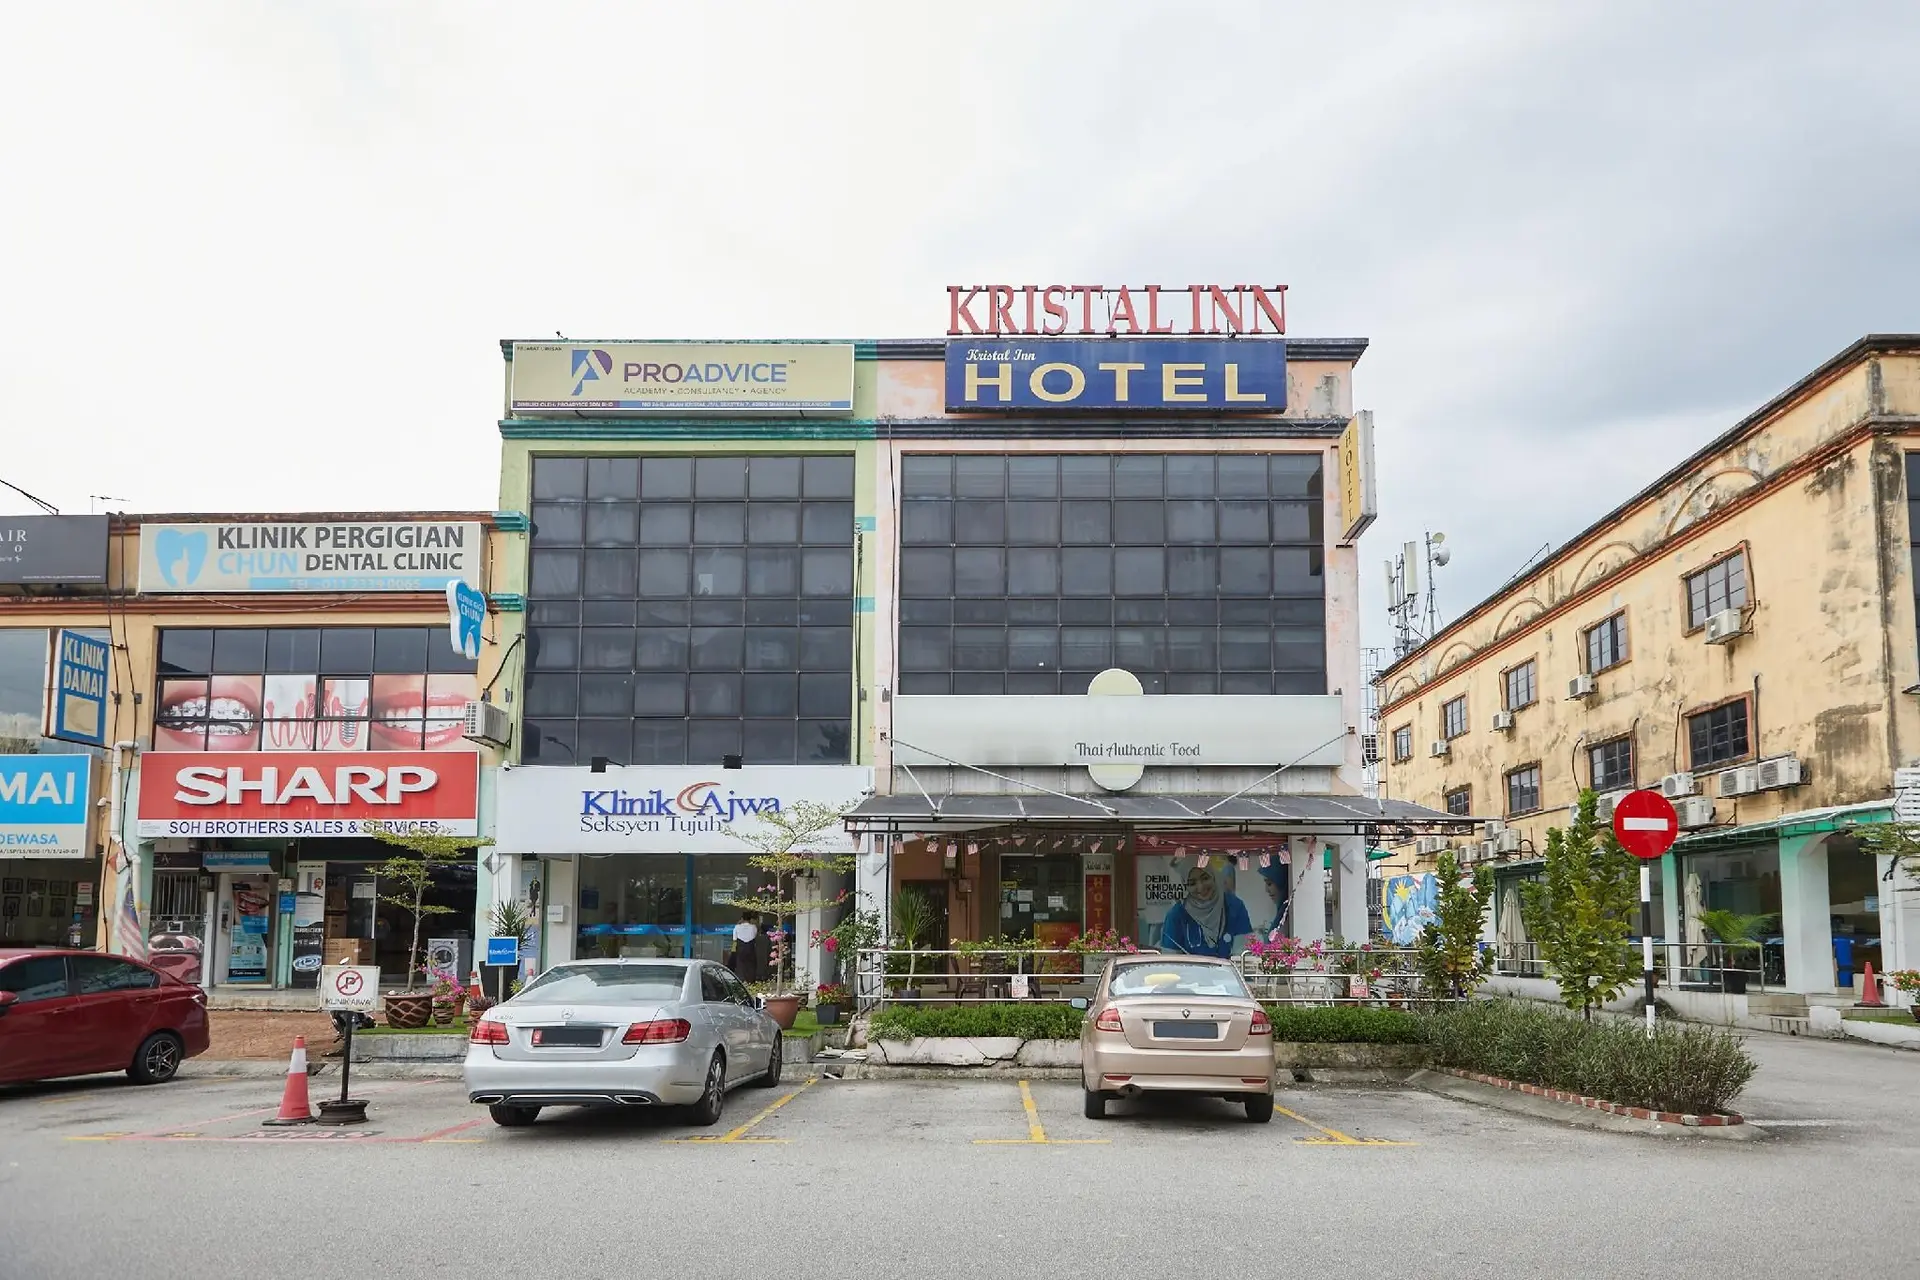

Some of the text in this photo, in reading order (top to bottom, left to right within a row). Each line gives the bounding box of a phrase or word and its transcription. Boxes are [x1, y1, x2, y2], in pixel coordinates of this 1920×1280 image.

[947, 285, 1288, 335] KRISTAL INN
[965, 348, 1036, 362] Kristal Inn
[624, 363, 787, 383] PROADVICE
[964, 362, 1267, 402] HOTEL
[1345, 430, 1354, 523] HOTEL
[218, 526, 464, 549] KLINIK PERGIGIAN
[218, 552, 463, 575] CHUN DENTAL CLINIC
[64, 636, 105, 671] KLINIK
[63, 664, 103, 698] DAMAI
[1074, 742, 1201, 757] Thai Authentic Food
[173, 766, 439, 805] SHARP
[580, 790, 781, 823] Klinik Ajwa
[169, 821, 200, 834] SOH
[205, 821, 288, 834] BROTHERS
[293, 821, 343, 834] SALES
[348, 821, 358, 834] &
[580, 816, 721, 836] Seksyen Tujuh
[1145, 875, 1169, 883] DEMI
[1145, 883, 1189, 891] KHIDMAT
[1145, 891, 1188, 900] UNGGUL
